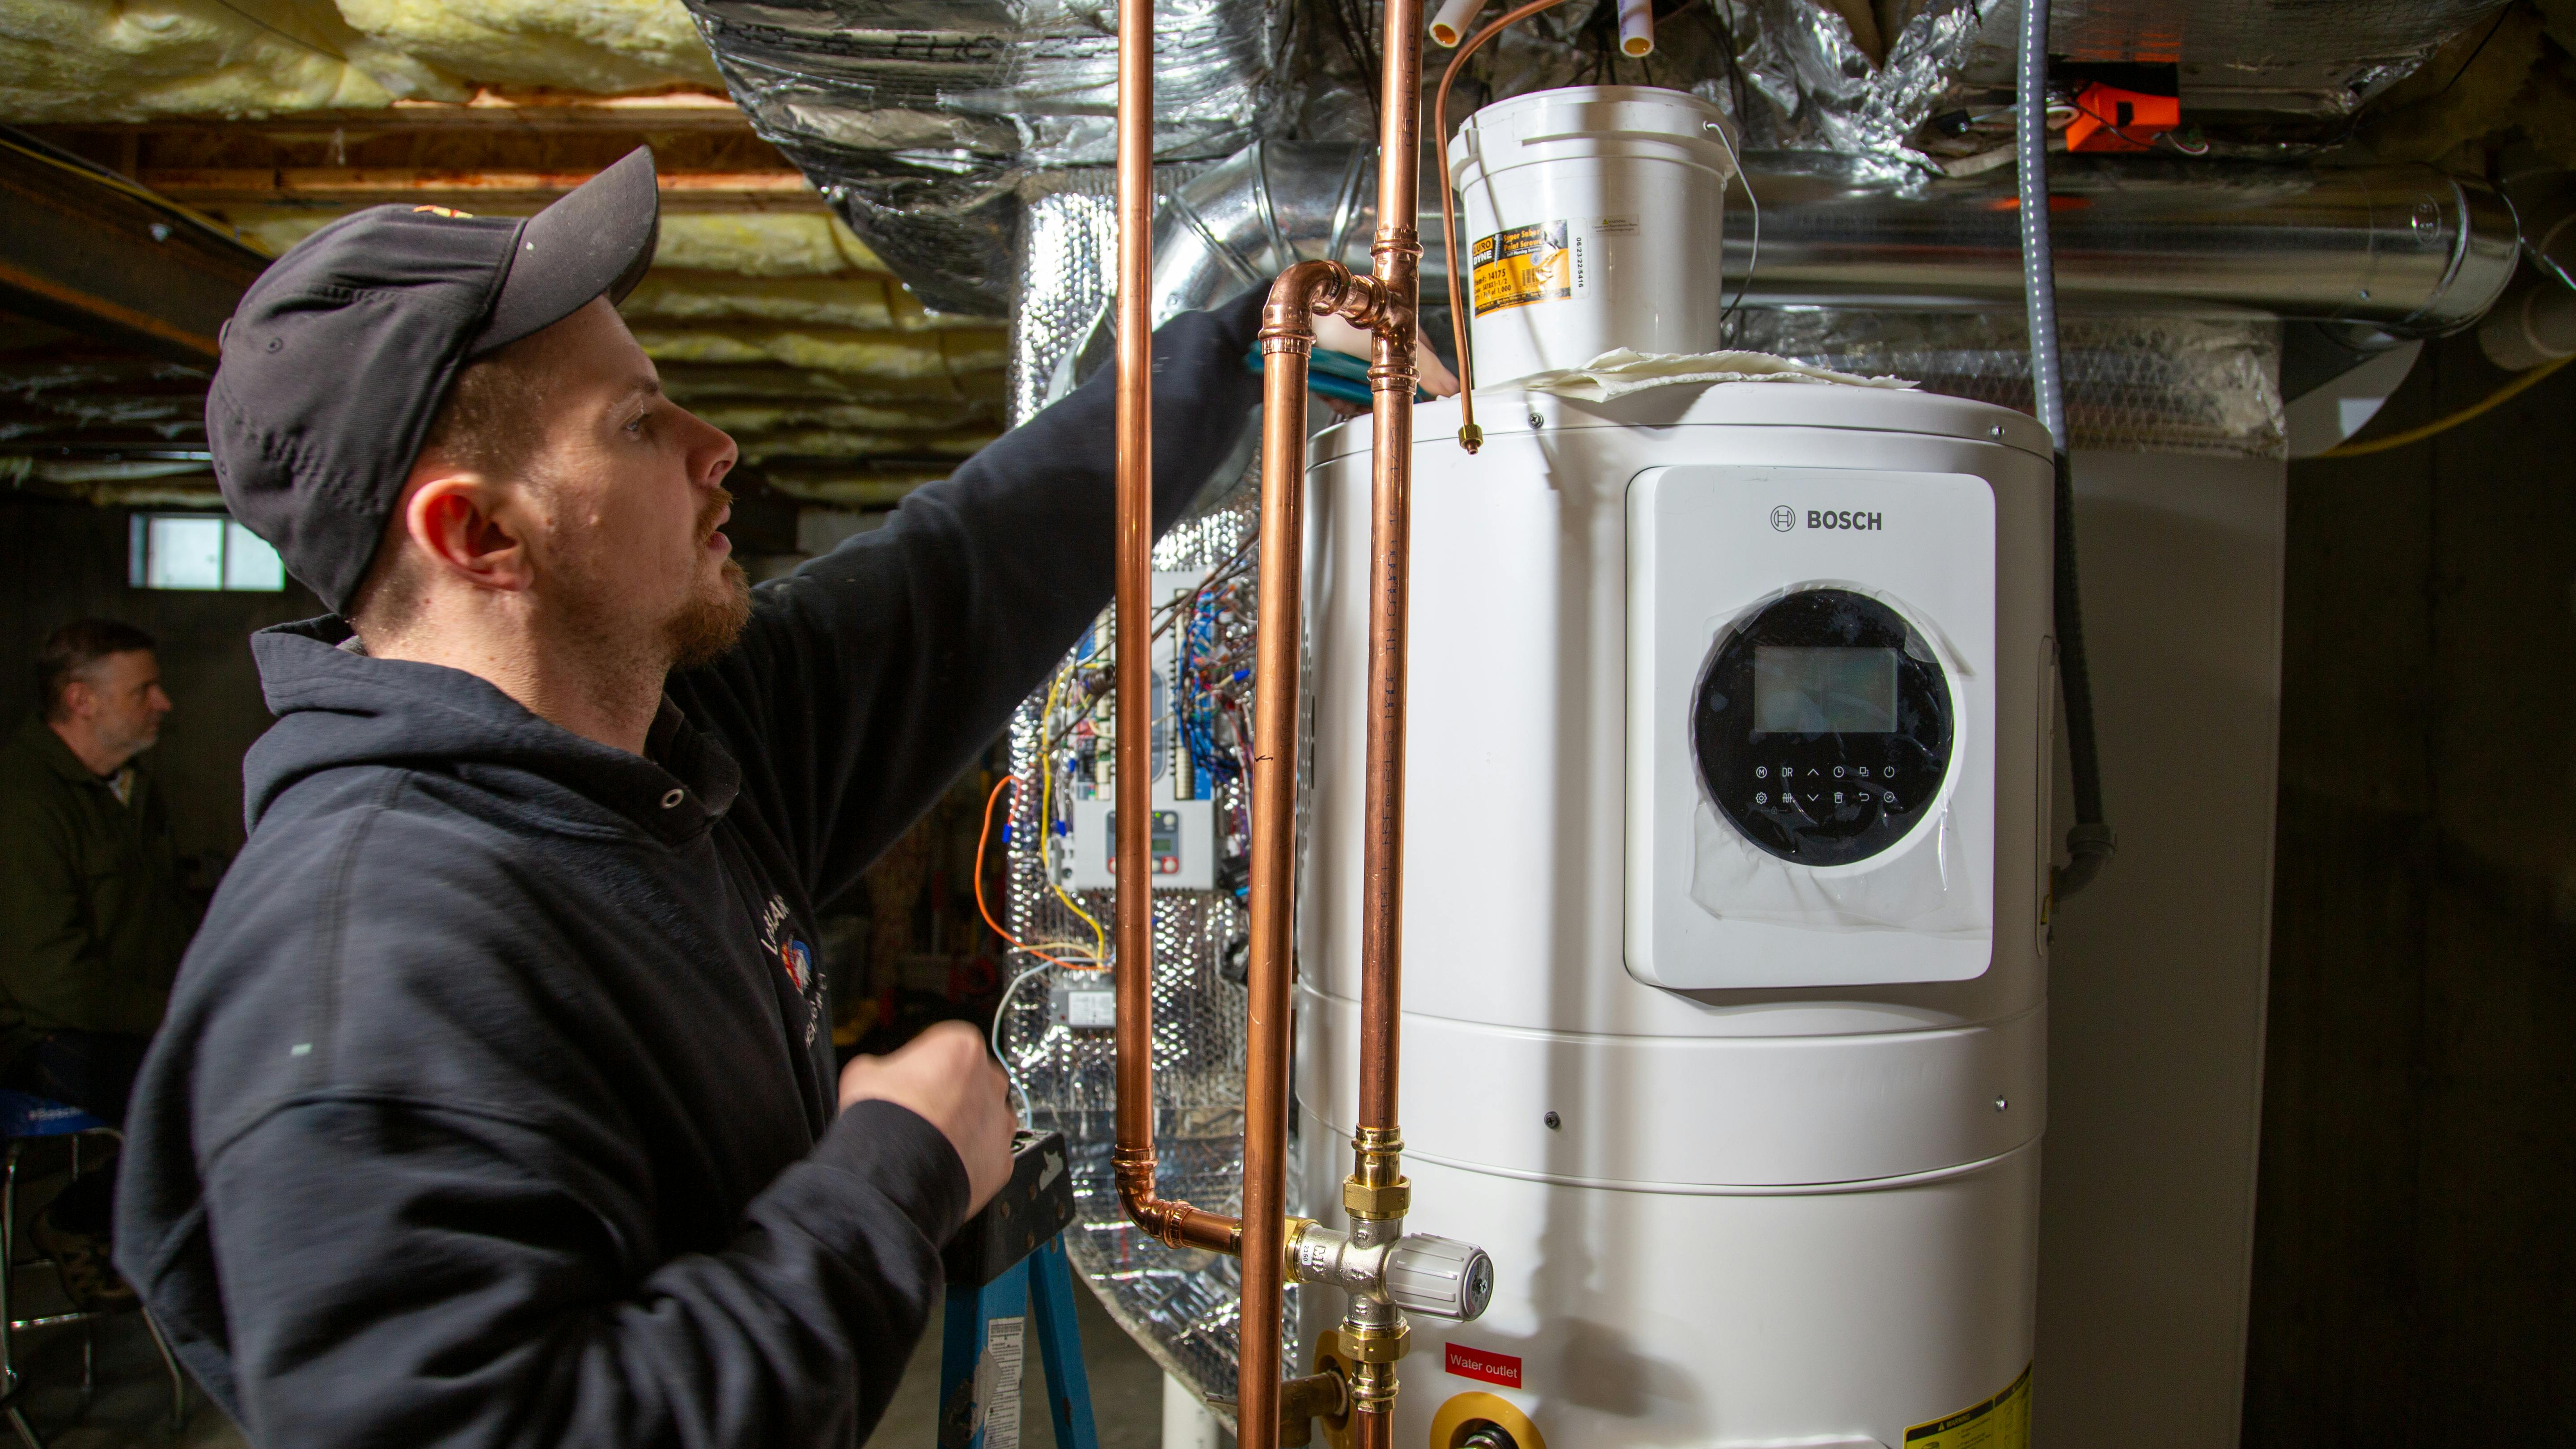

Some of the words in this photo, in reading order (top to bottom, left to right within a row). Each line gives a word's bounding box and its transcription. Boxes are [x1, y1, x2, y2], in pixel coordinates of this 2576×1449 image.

[1504, 233, 1520, 242] Super
[1488, 269, 1506, 280] 14175
[1807, 510, 1882, 530] BOSCH
[1782, 767, 1792, 777] DR
[1450, 1354, 1483, 1371] Water
[1485, 1364, 1517, 1379] outlet
